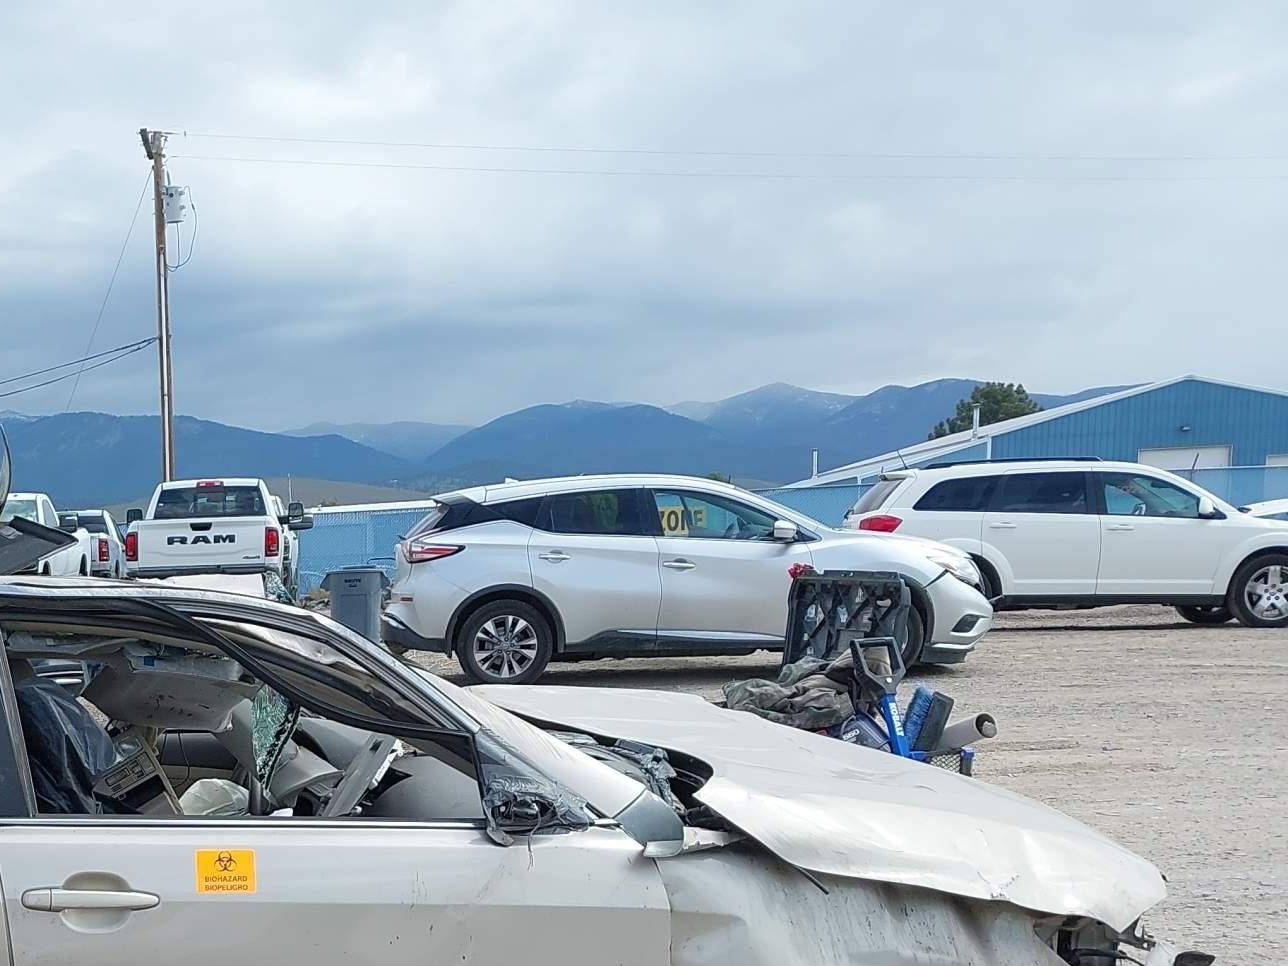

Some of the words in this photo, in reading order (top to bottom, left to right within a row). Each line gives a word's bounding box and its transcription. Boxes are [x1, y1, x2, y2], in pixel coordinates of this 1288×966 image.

[167, 534, 236, 546] RAM
[888, 702, 905, 737] KOBALT
[204, 875, 248, 883] BIOHAZARD
